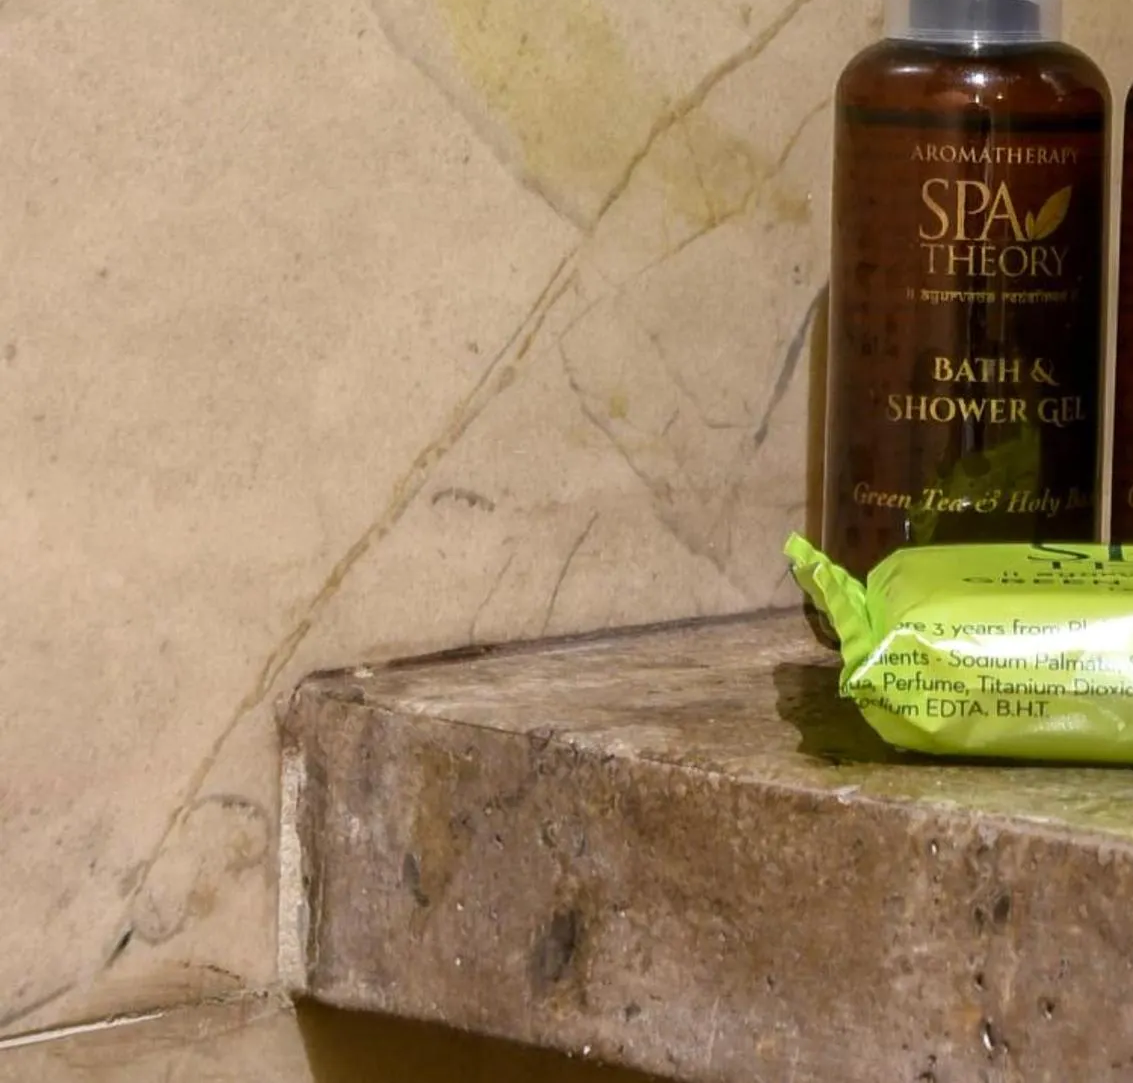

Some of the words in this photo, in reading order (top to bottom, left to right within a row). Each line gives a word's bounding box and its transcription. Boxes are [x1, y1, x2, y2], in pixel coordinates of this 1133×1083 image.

[911, 144, 1079, 164] AROMATHERAPY
[919, 177, 1032, 242] SPA
[919, 243, 1068, 277] THEORY
[933, 356, 1022, 383] BATH
[1029, 358, 1060, 387] &
[886, 393, 1028, 423] SHOWER
[1037, 397, 1086, 428] GEL
[853, 481, 912, 509] Green
[923, 487, 970, 512] Tea
[1007, 488, 1061, 518] Holy
[932, 622, 945, 637] 3
[952, 622, 1006, 639] years
[1012, 618, 1062, 636] from
[883, 671, 970, 697] Perfume,
[977, 674, 1067, 696] Titanium
